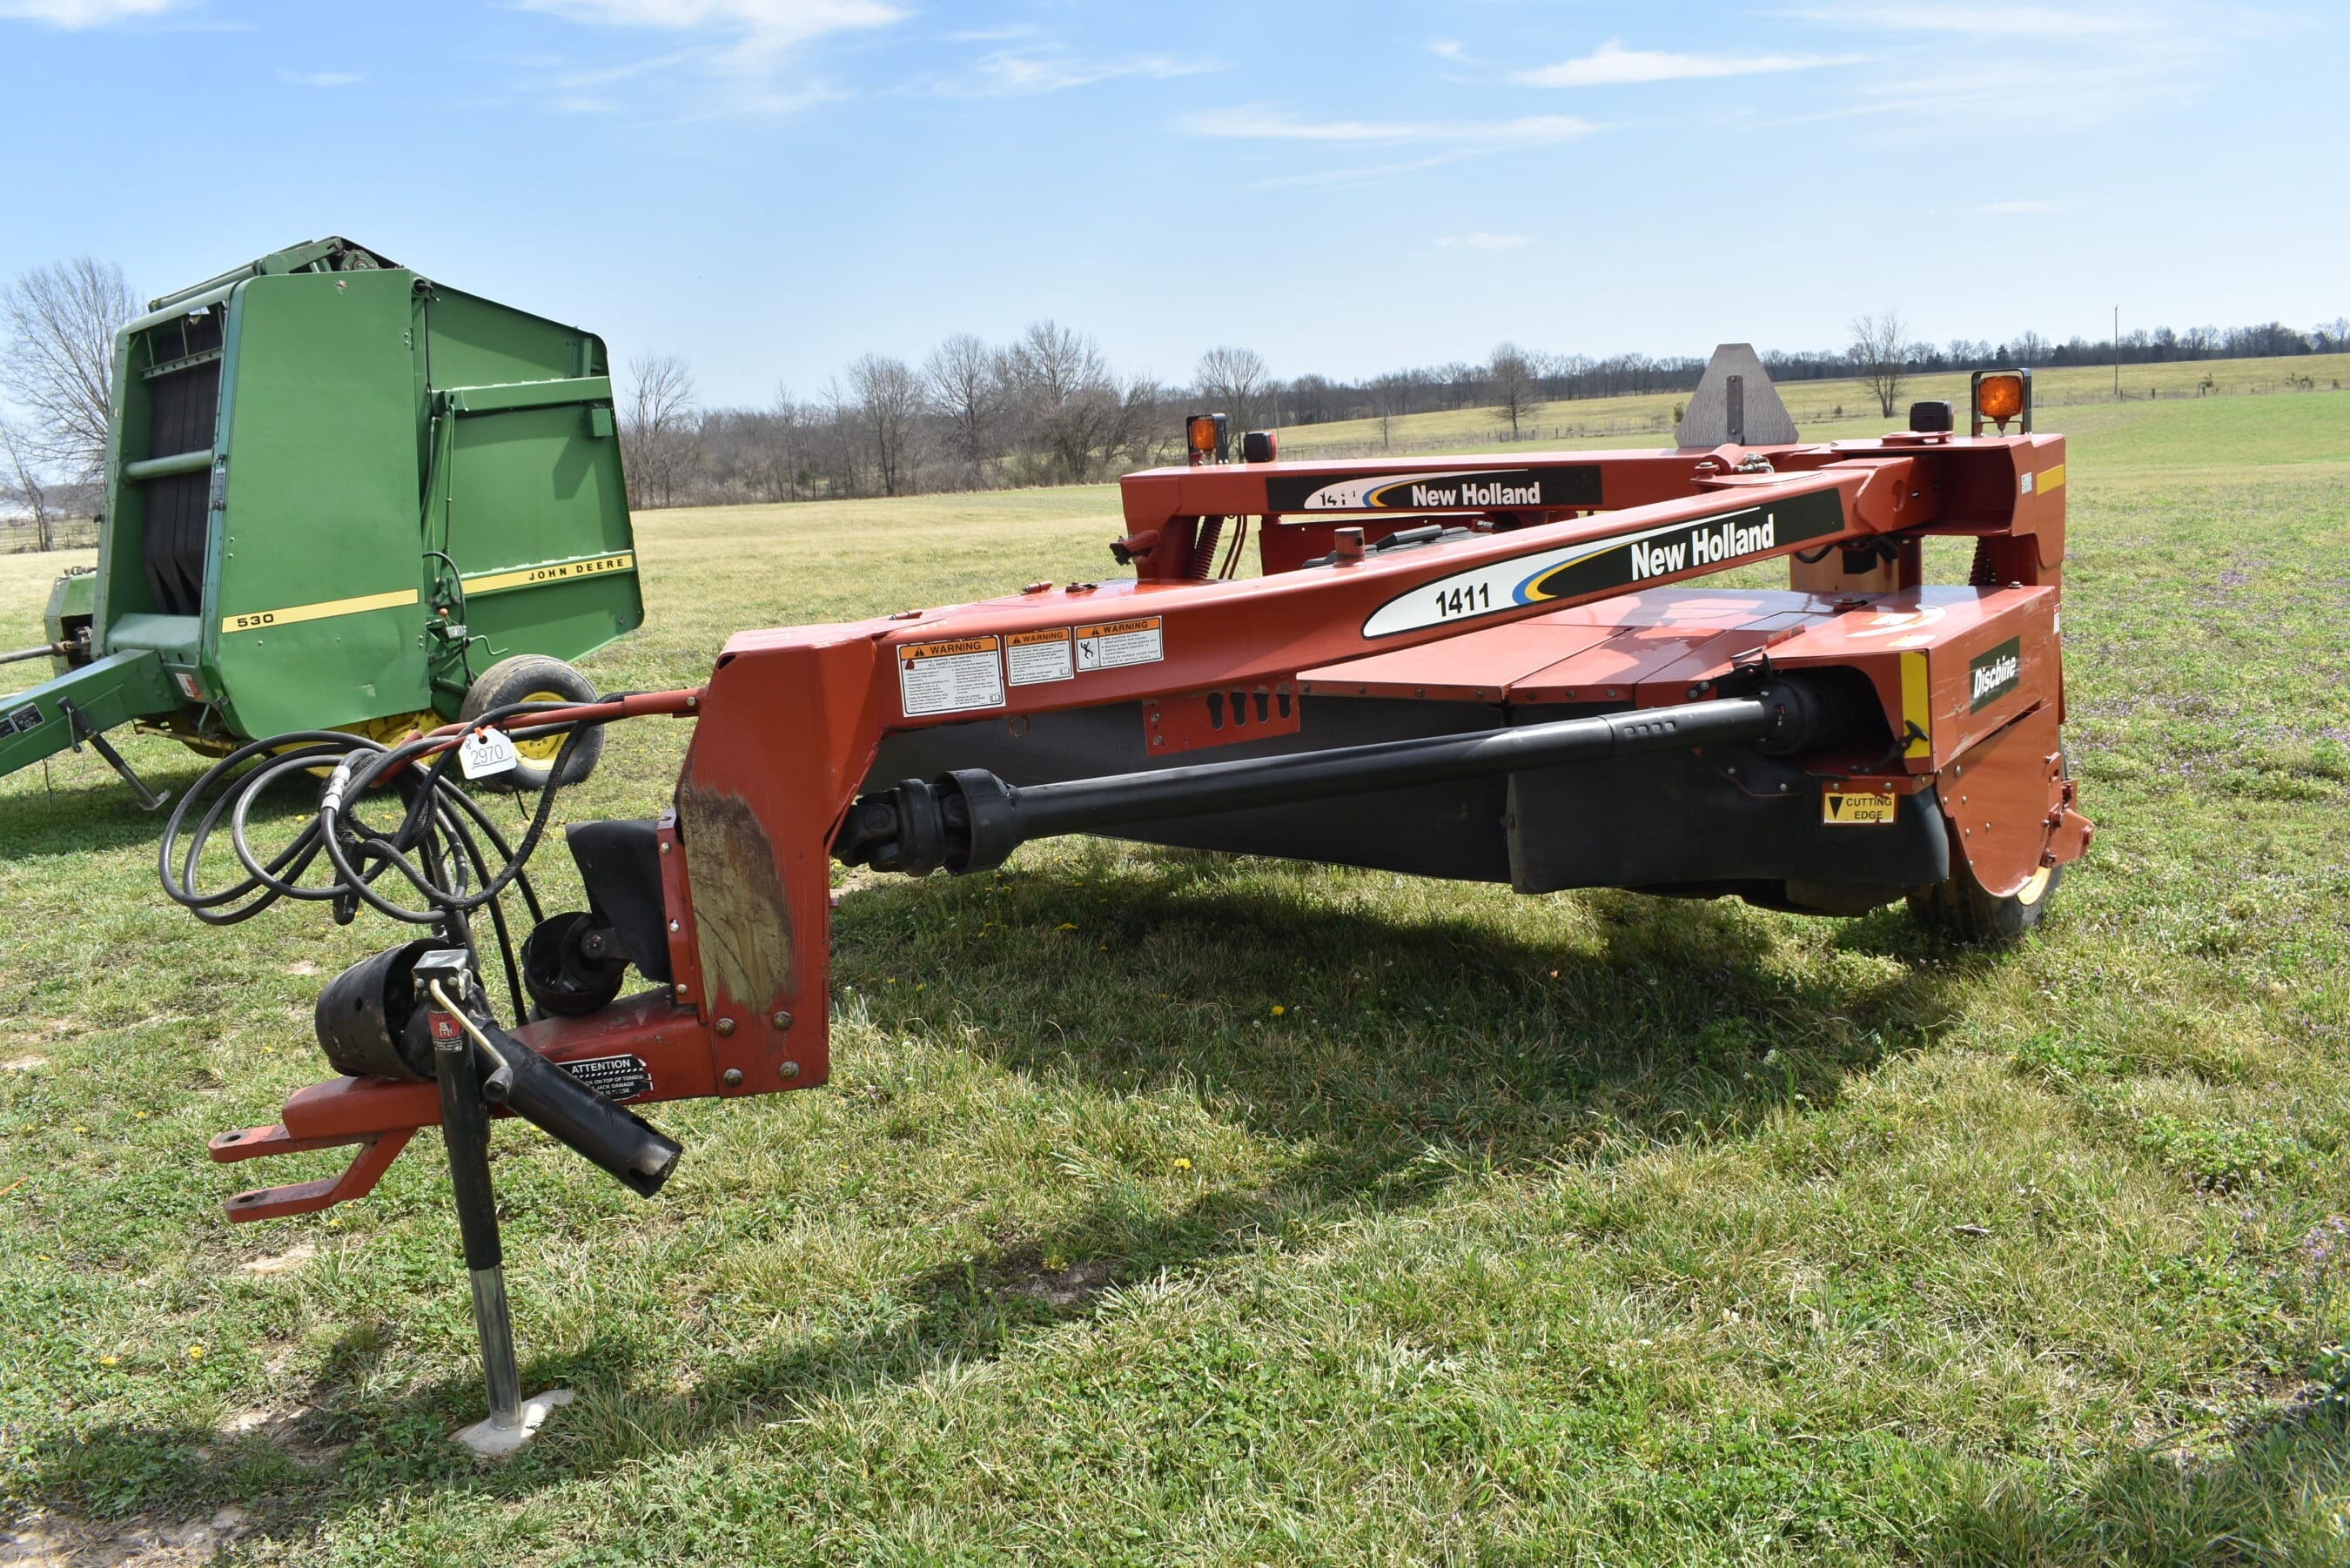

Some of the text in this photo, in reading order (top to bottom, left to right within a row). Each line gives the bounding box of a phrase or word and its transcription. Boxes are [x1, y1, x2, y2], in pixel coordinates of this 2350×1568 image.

[1411, 484, 1458, 506] New
[1462, 481, 1541, 506] Holland
[528, 559, 624, 581] JOHN DEERE
[1434, 513, 1775, 618] 1411 New Holland
[237, 613, 274, 628] 530
[1104, 621, 1149, 634] WARNING
[1023, 632, 1064, 642] WARNING
[930, 641, 982, 655] WARNING
[1973, 655, 2017, 699] Discbine
[470, 744, 503, 766] 2970
[1846, 795, 1892, 807] CUTTING
[1854, 810, 1883, 820] EDGE
[571, 1059, 631, 1074] ATTENTION
